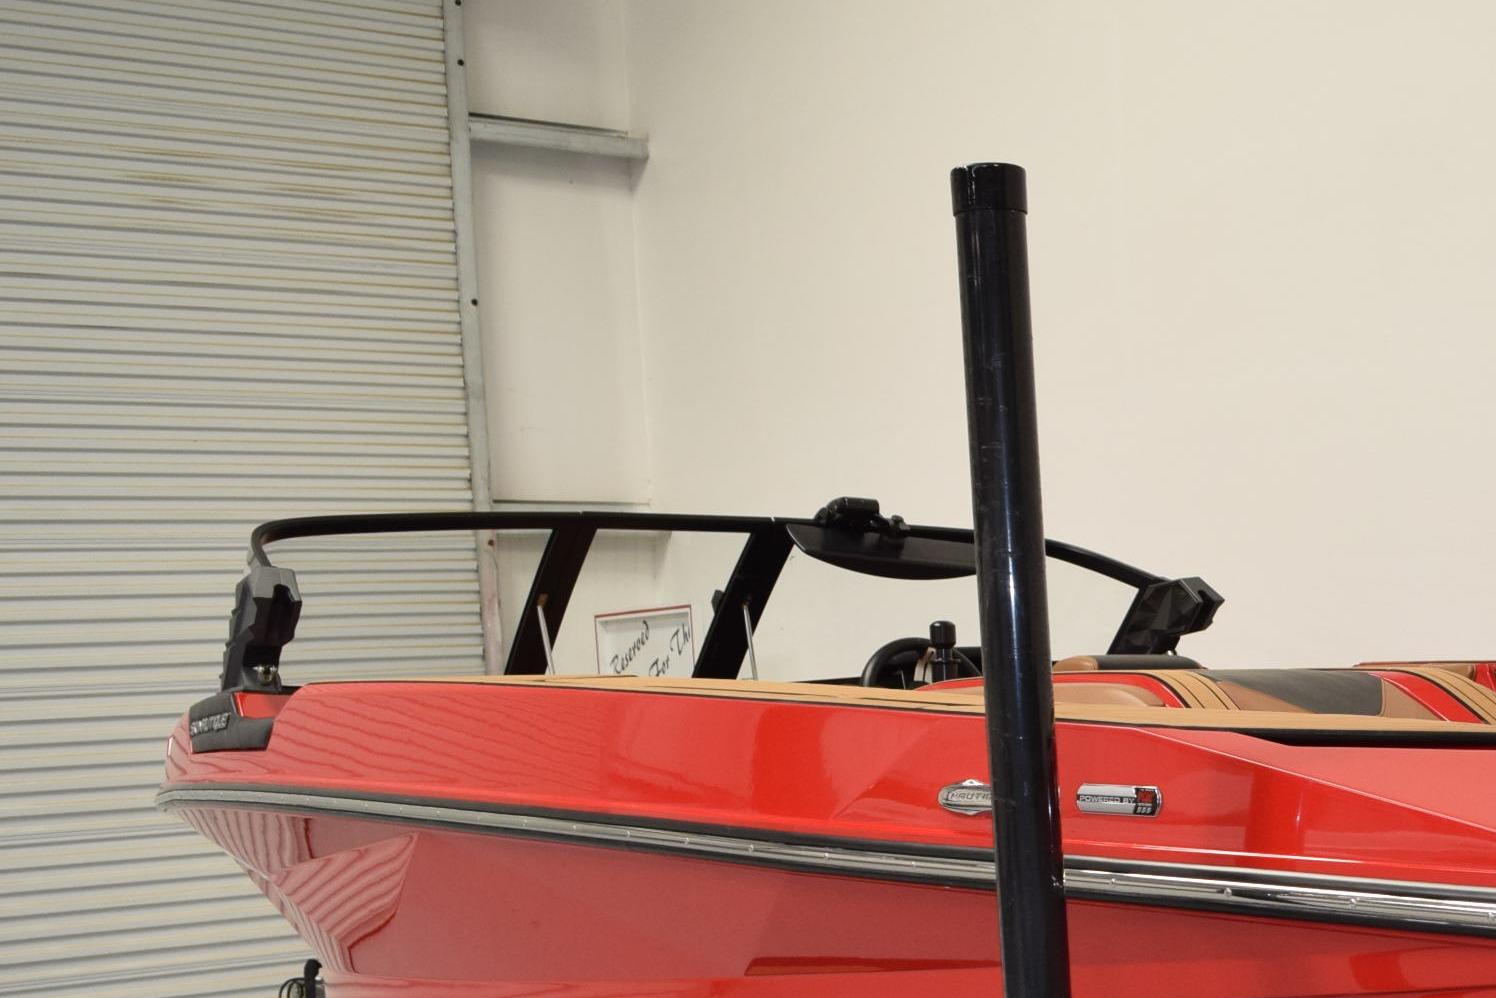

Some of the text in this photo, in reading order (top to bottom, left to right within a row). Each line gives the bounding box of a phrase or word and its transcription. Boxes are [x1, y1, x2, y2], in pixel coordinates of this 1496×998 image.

[609, 620, 649, 675] Reserved
[1079, 795, 1135, 805] POWERED BY
